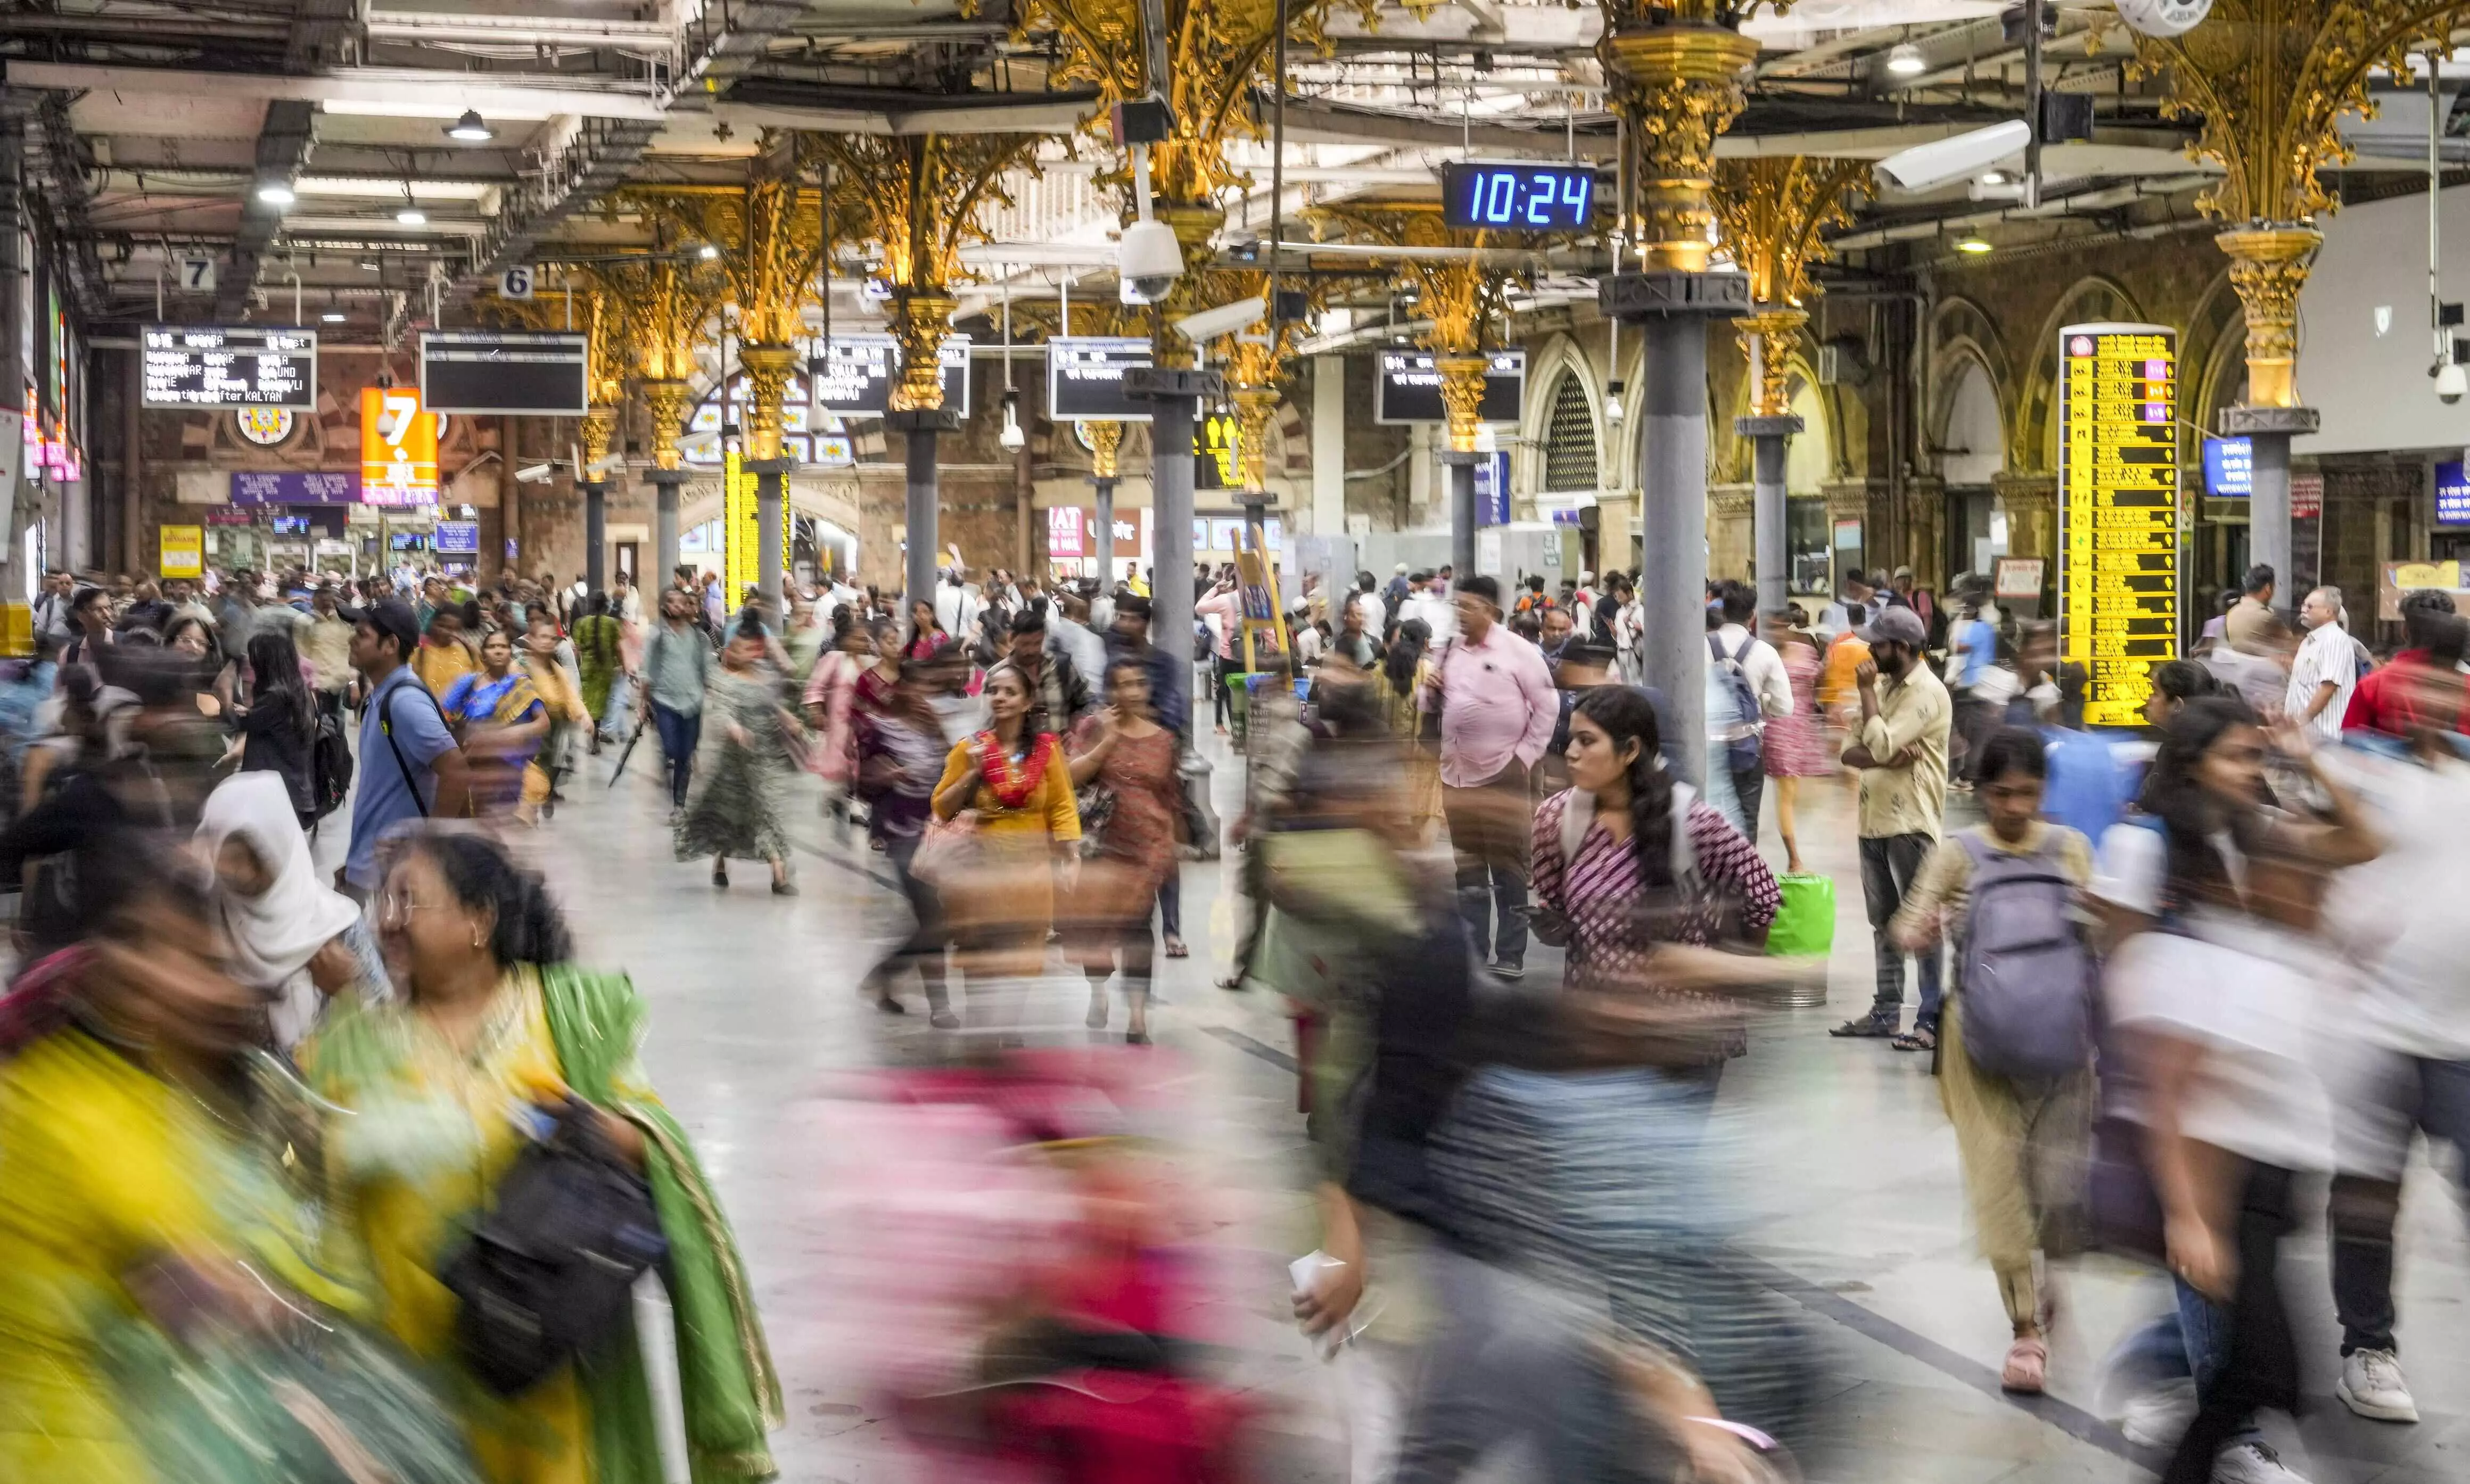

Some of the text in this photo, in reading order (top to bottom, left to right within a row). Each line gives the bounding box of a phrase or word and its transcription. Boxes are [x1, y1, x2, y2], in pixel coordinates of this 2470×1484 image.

[1471, 172, 1588, 225] 10:24
[185, 260, 209, 287] 7
[506, 270, 528, 294] 6
[245, 391, 282, 402] KALYAN
[386, 397, 416, 445] 7
